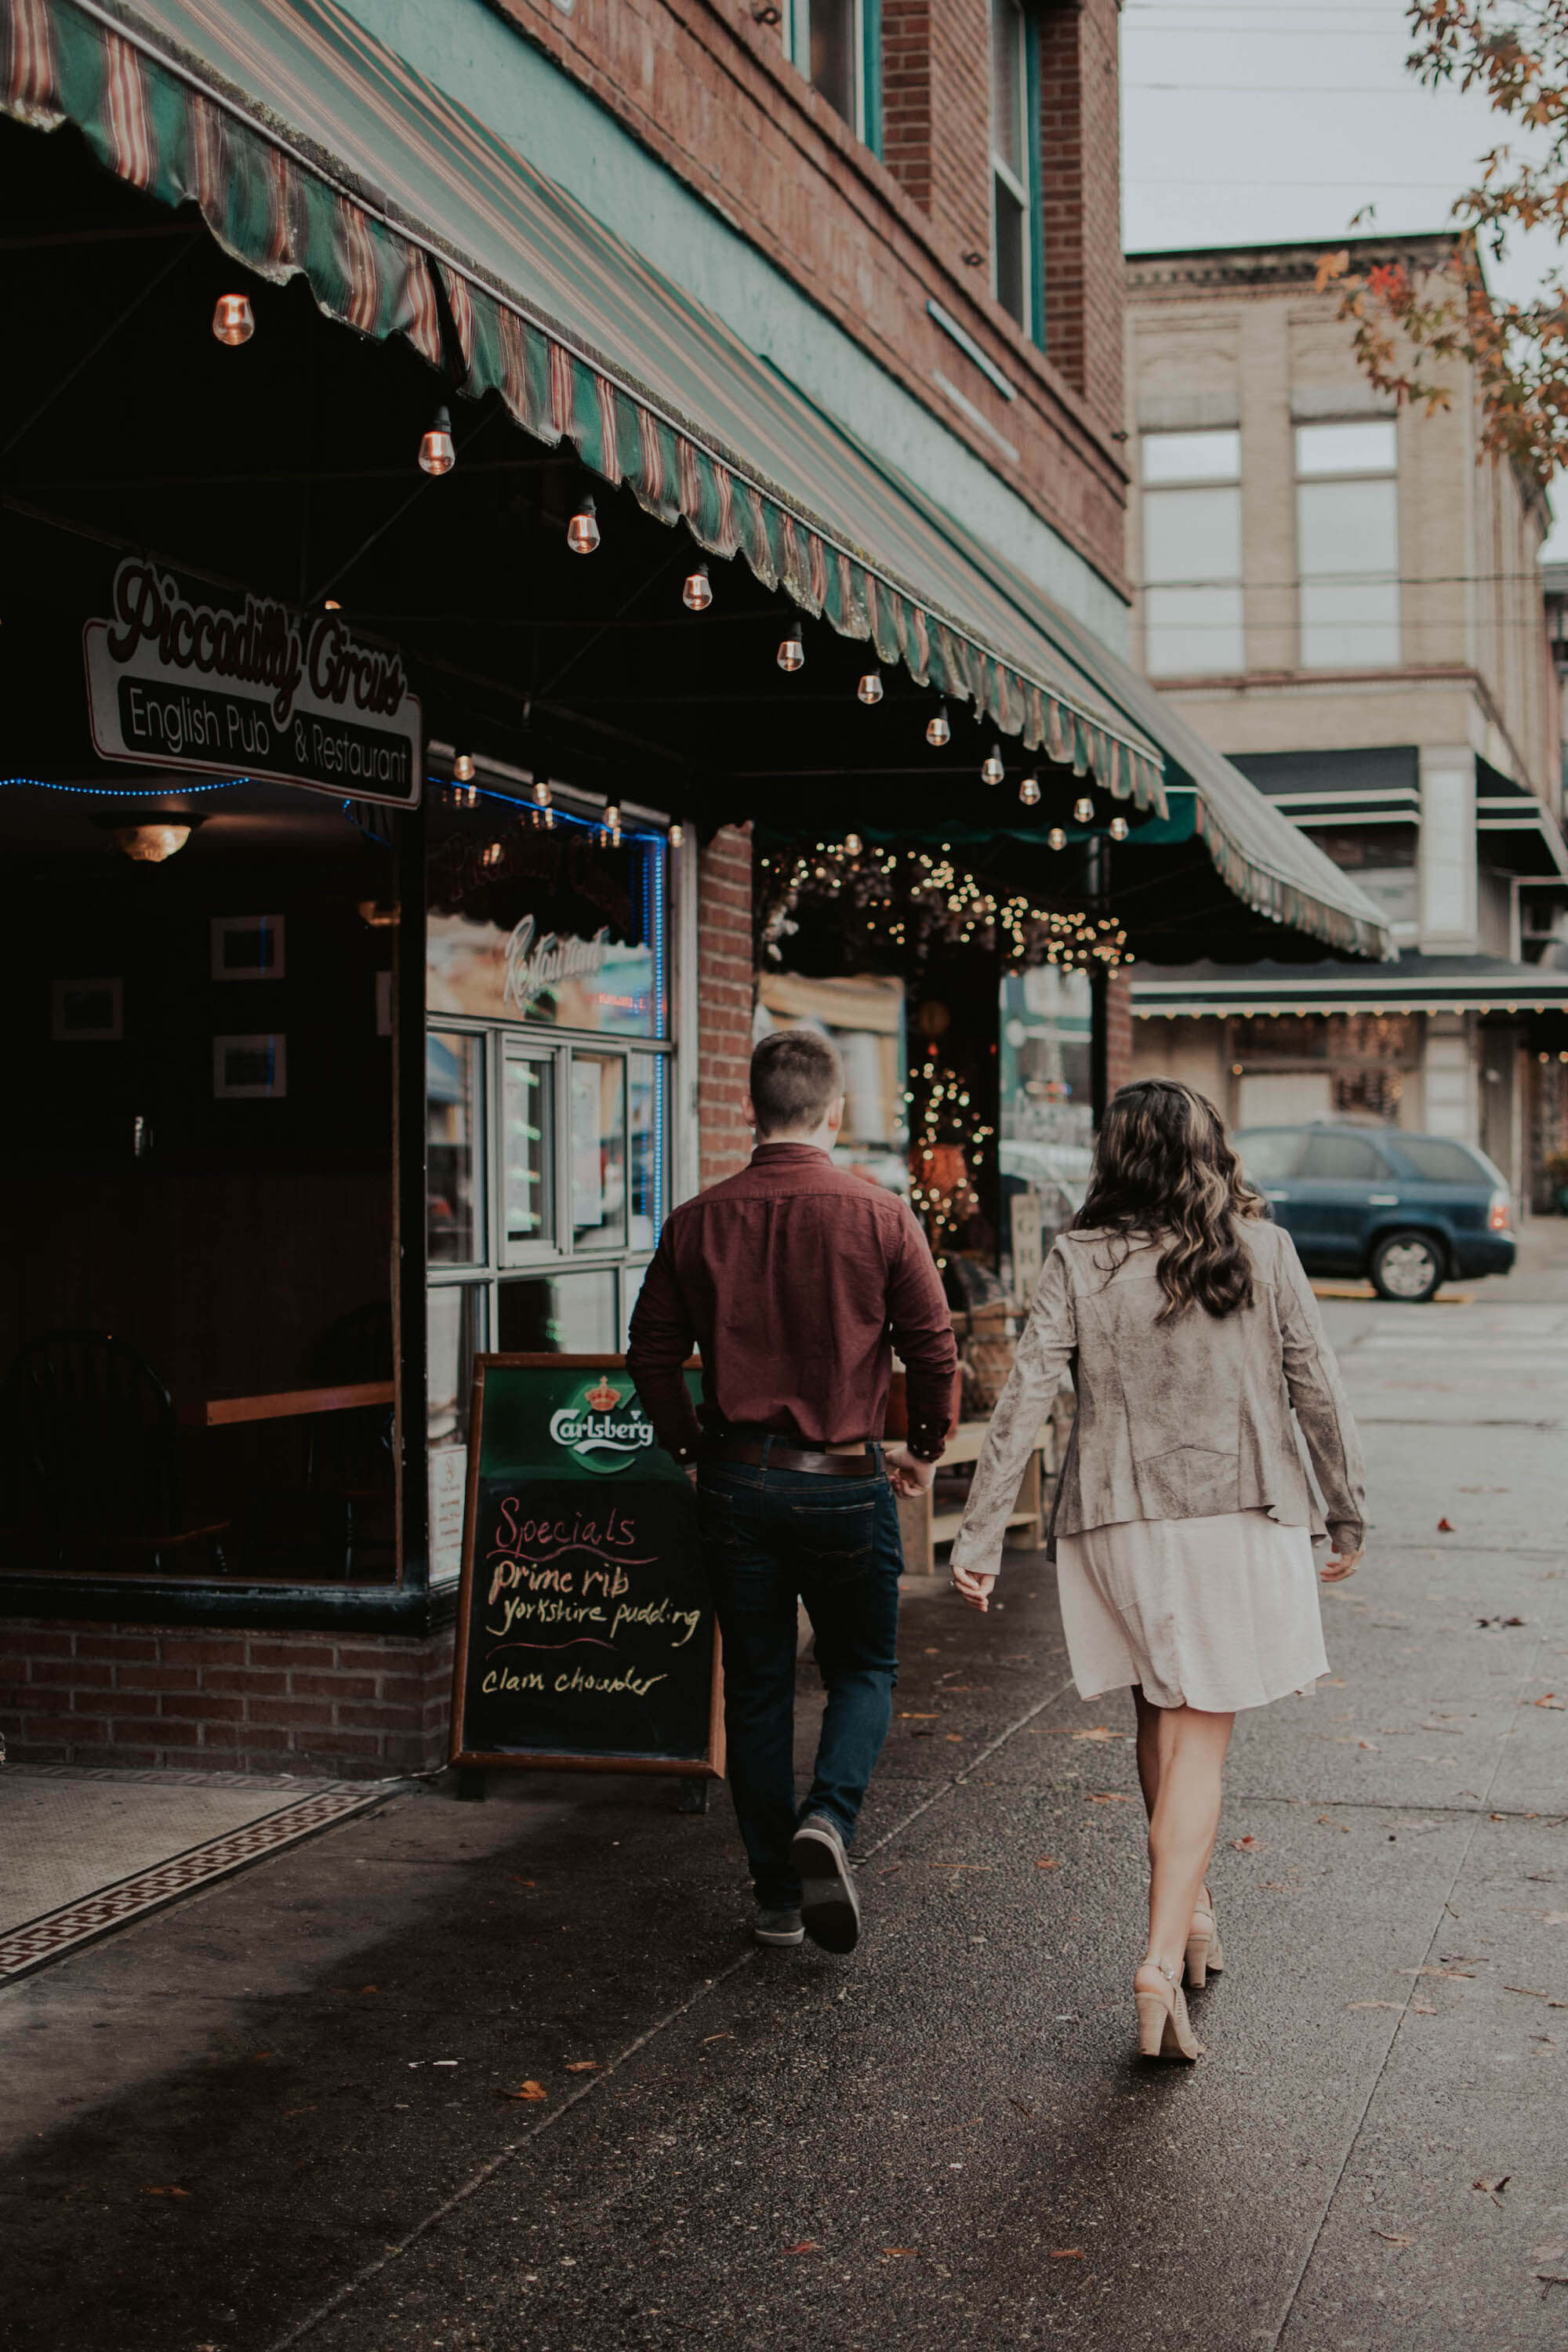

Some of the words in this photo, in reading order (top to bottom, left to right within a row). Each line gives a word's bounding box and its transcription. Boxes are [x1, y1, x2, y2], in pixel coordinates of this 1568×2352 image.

[107, 563, 301, 725] Piccadilly
[308, 617, 407, 717] Circus
[129, 687, 221, 753] English
[227, 705, 270, 755] Pub
[294, 718, 309, 764] &
[313, 723, 407, 785] Restaurant
[550, 1408, 654, 1449] Carlsberg
[495, 1496, 636, 1559] Specials
[582, 1563, 629, 1599] rib
[610, 1597, 701, 1647] pudding
